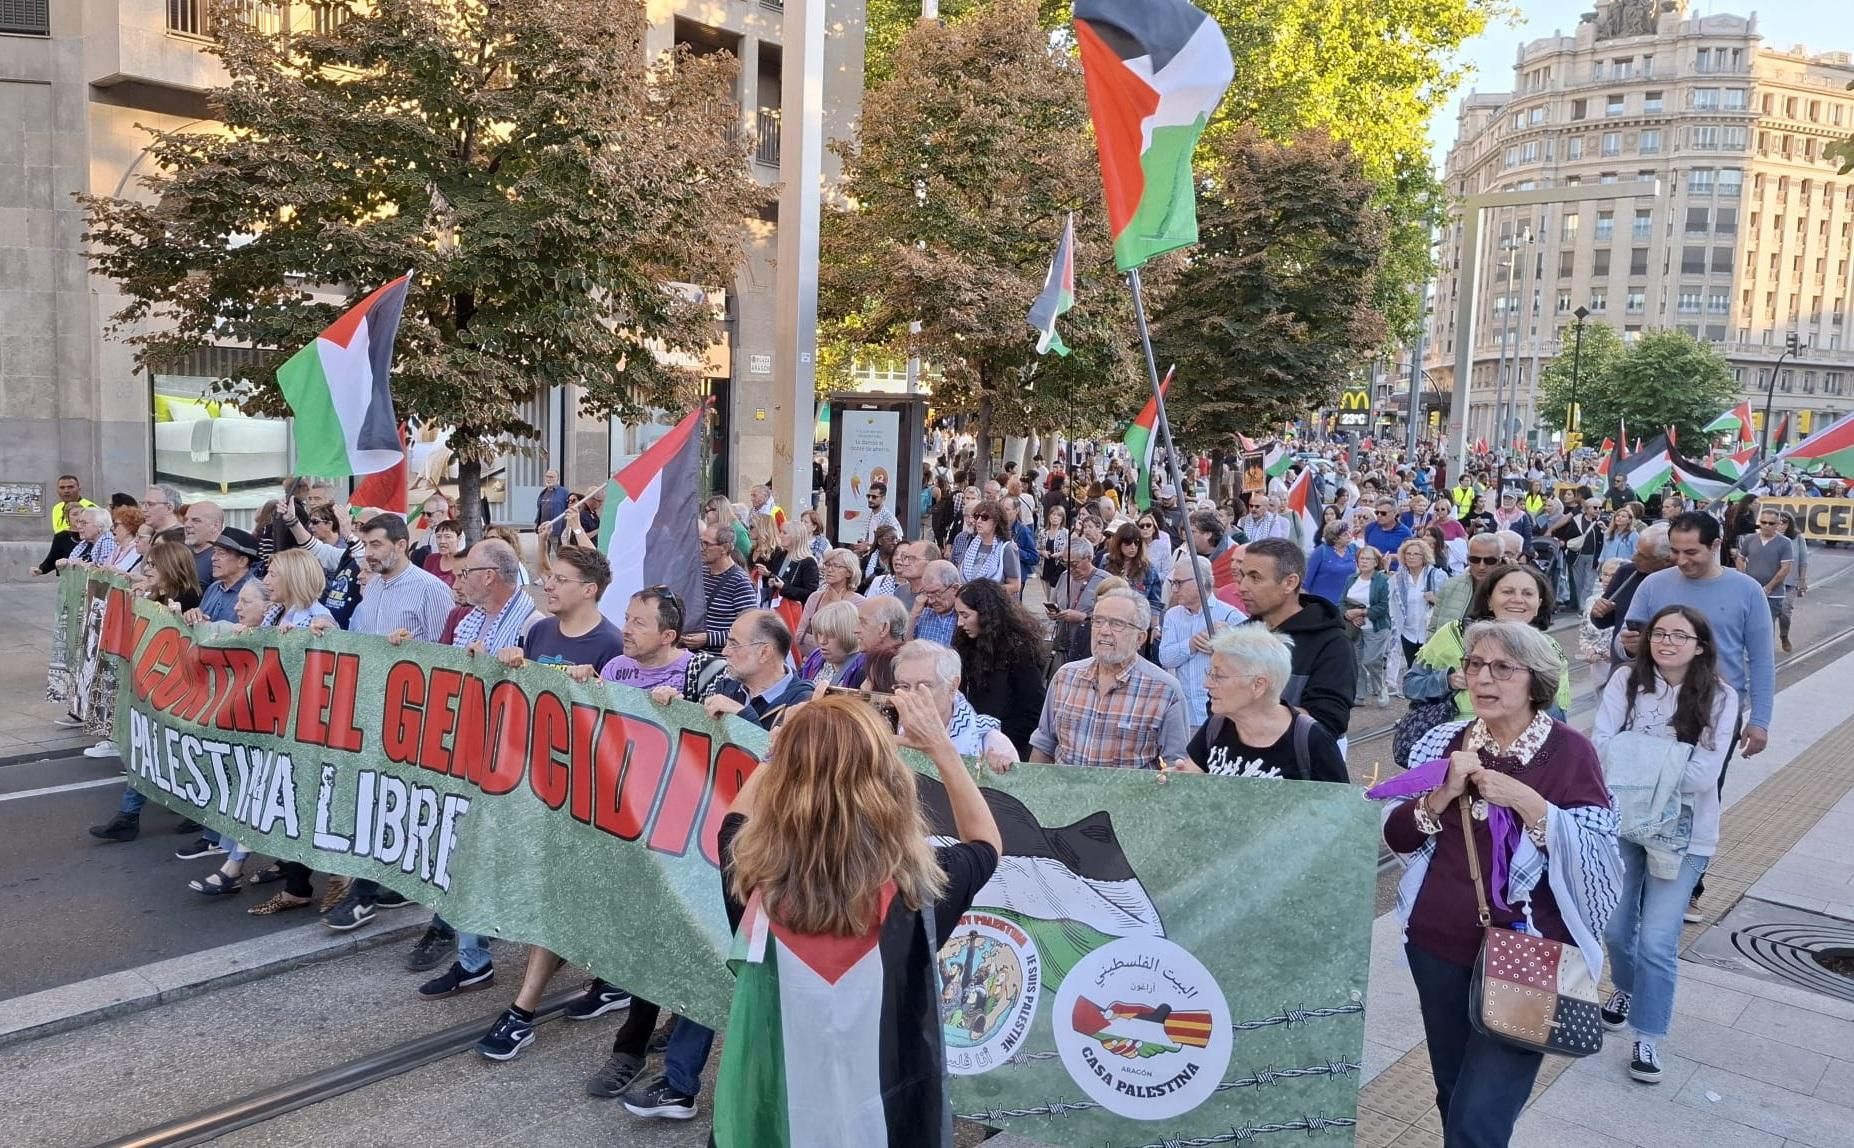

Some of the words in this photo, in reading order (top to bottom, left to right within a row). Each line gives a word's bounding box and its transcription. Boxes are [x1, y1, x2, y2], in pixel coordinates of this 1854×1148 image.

[1761, 503, 1854, 536] NCE
[134, 626, 291, 738] CONTRA
[295, 648, 363, 753] EL
[130, 706, 299, 839] PALESTINA
[313, 762, 472, 894] LIBRE
[1026, 966, 1038, 993] SUIS
[1094, 954, 1160, 988] الفلسطيني
[1162, 968, 1199, 999] البيت
[1000, 995, 1034, 1053] PALESTINE
[1081, 1046, 1113, 1087] CASA
[1115, 1062, 1200, 1098] PALESTINA
[1120, 1066, 1153, 1078] ARAGÓN
